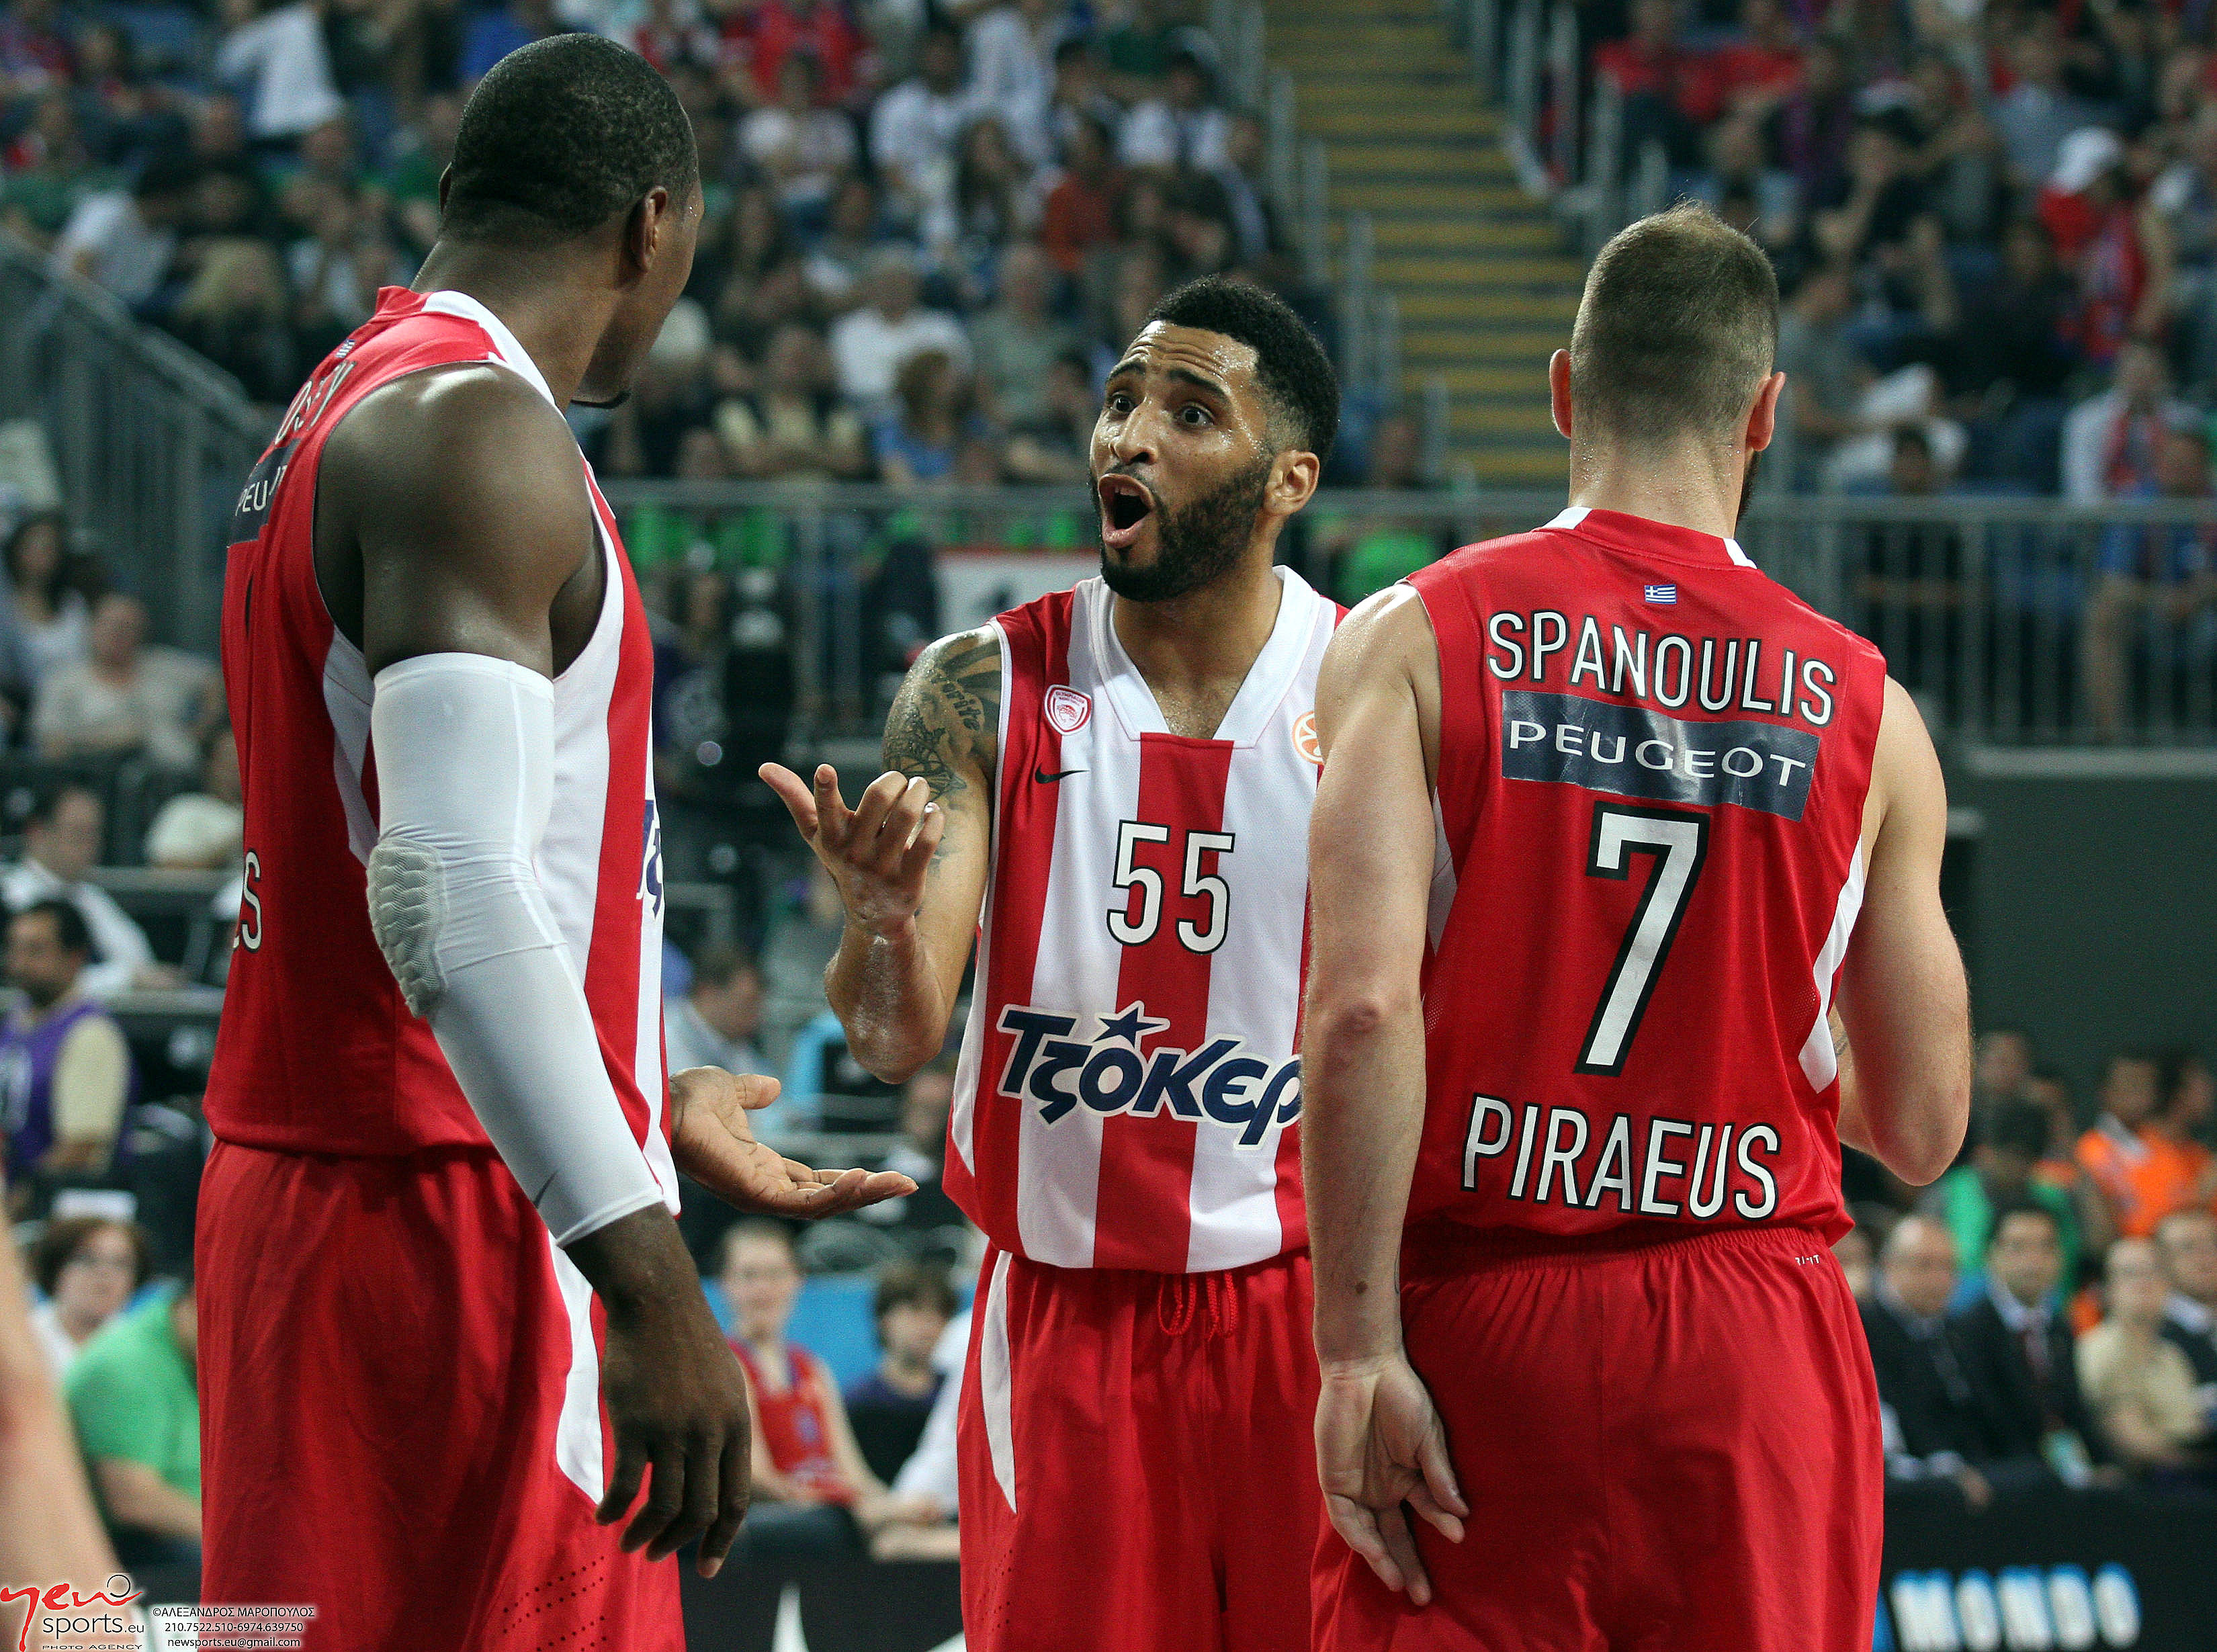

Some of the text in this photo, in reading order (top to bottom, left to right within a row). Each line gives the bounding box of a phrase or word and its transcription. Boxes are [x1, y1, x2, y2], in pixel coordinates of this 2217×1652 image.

[1487, 609, 1838, 728] SPANOULIS
[1509, 720, 1807, 787] PEUGEOT
[1106, 819, 1235, 955] 55
[1573, 800, 1710, 1077] 7
[1460, 1092, 1782, 1221] PIRAEUS
[1889, 1563, 2143, 1652] MONDO
